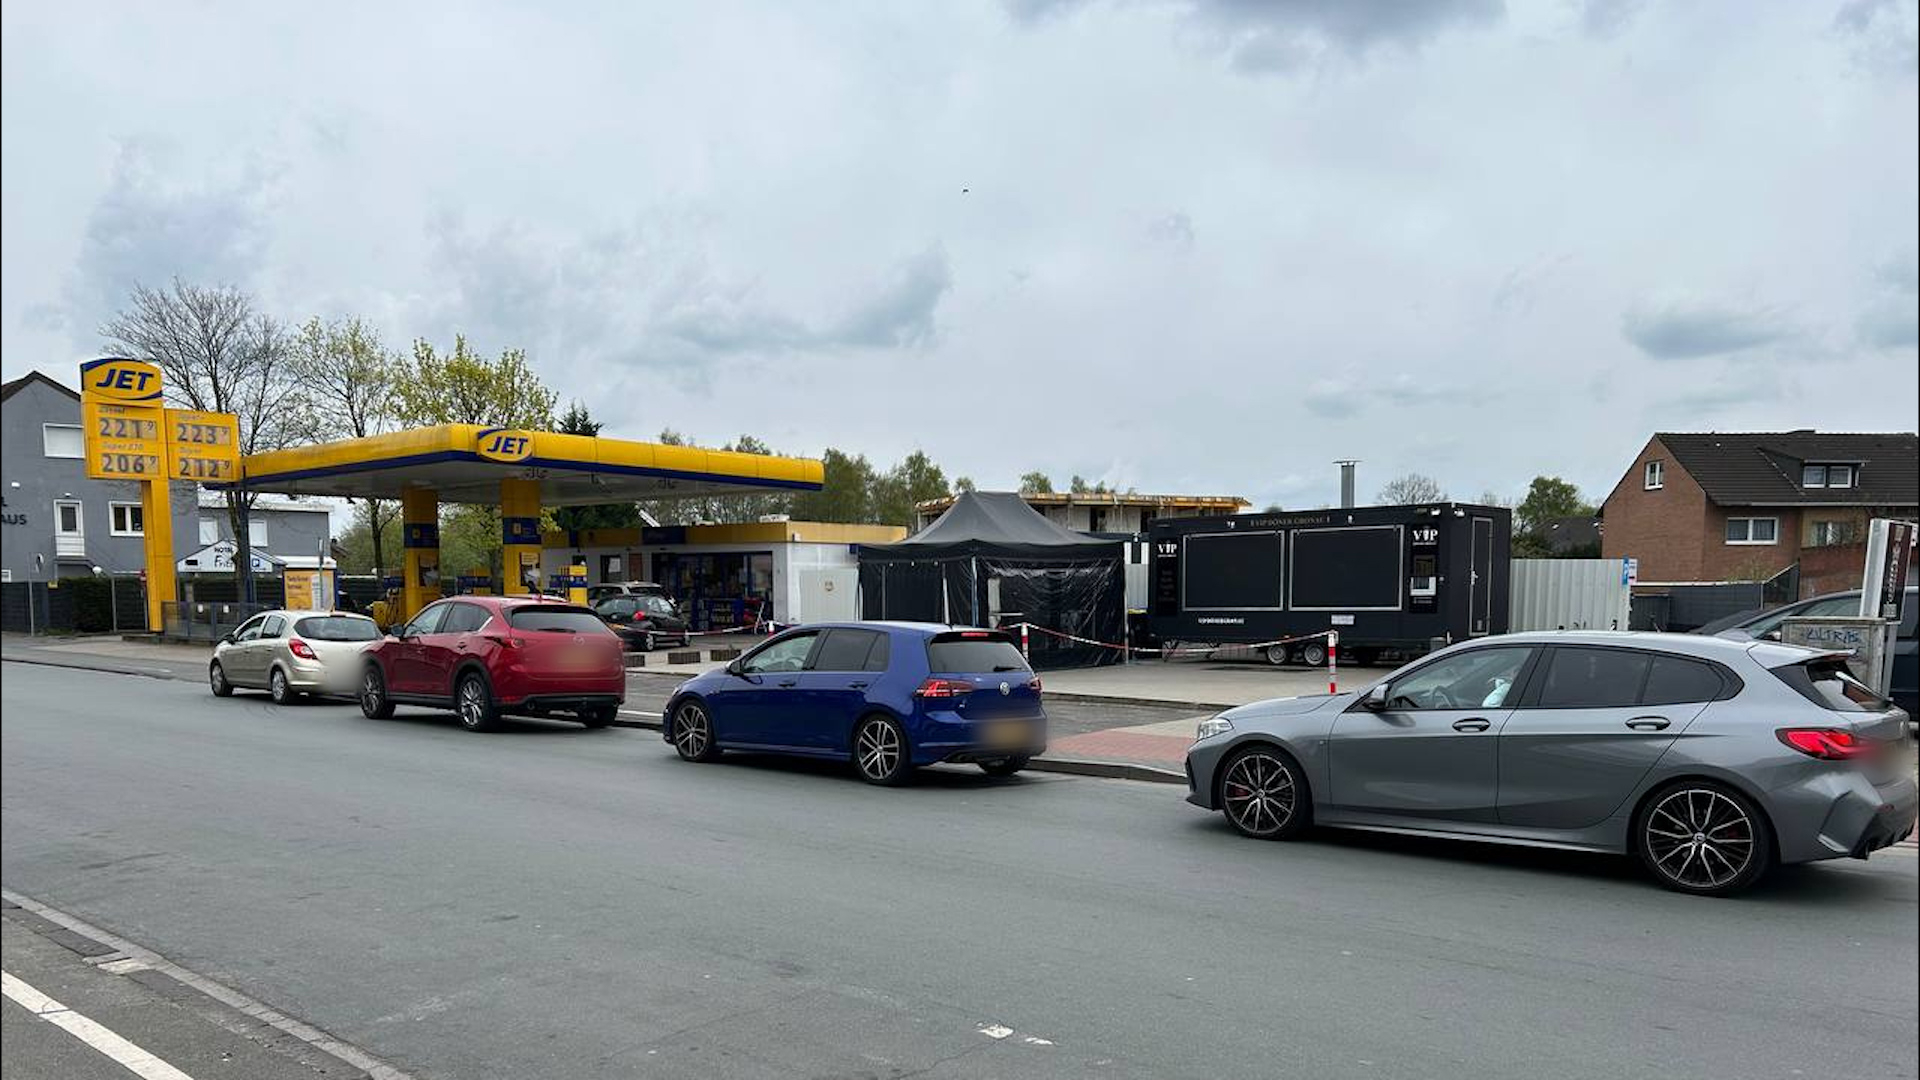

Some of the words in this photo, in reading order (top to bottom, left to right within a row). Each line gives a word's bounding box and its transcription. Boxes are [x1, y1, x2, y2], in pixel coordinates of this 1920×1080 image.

[96, 369, 154, 391] JET
[487, 436, 528, 454] JET
[1412, 529, 1438, 541] VIP
[1157, 543, 1178, 553] VIP
